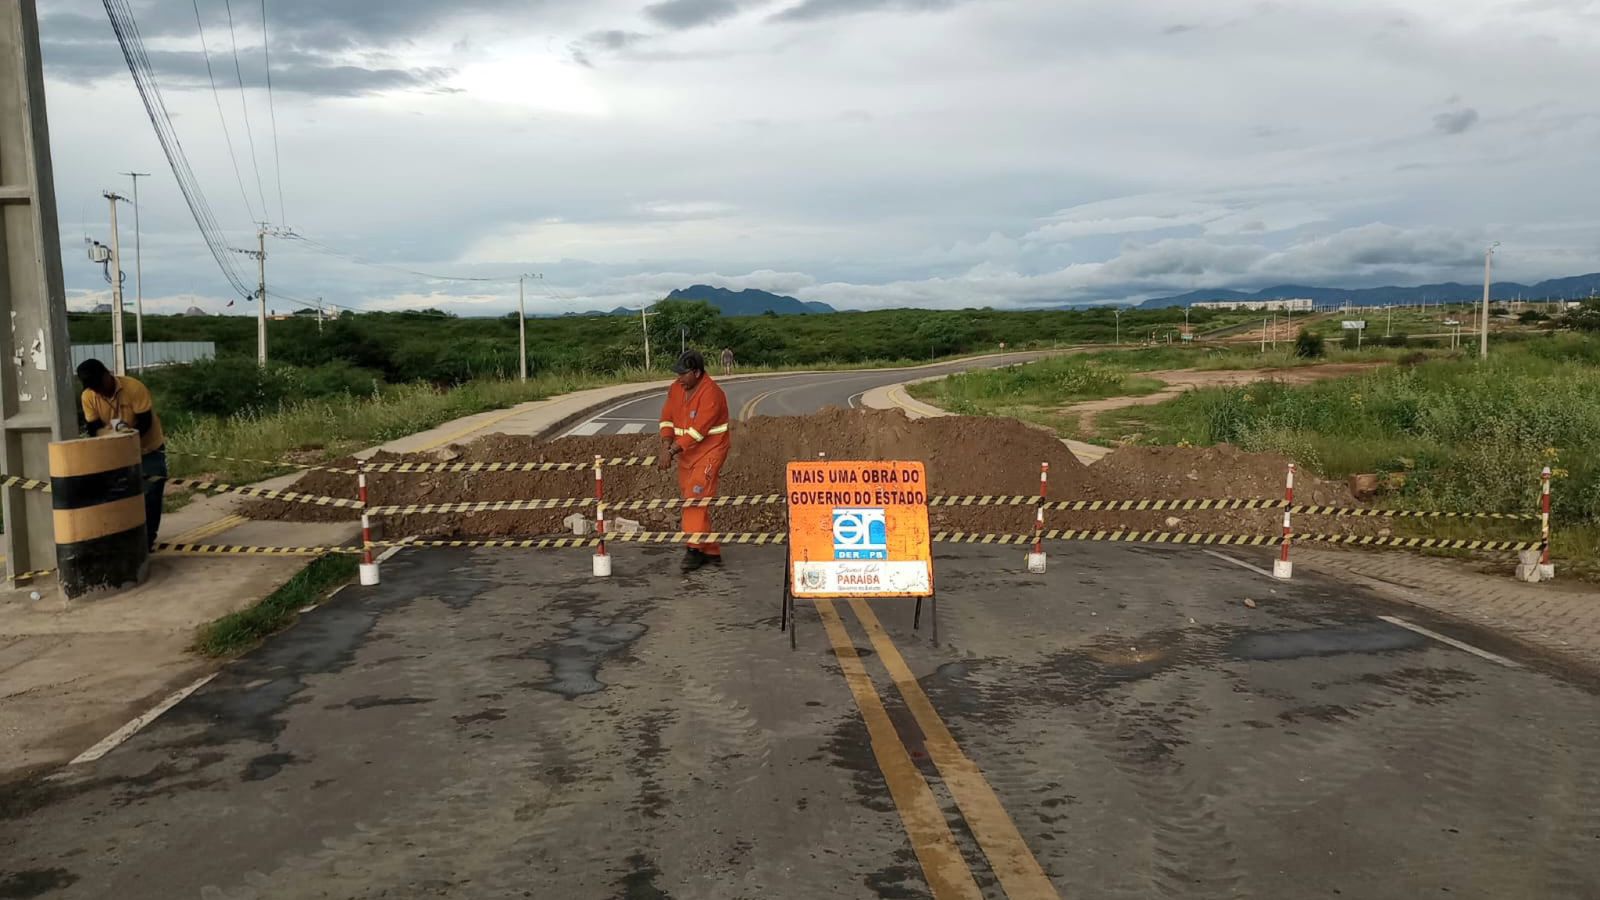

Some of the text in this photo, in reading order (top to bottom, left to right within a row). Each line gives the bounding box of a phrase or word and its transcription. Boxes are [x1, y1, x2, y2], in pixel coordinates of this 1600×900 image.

[792, 469, 919, 483] MAIS UMA OBRA DO
[791, 491, 923, 505] GOVERNO DO ESTADO
[838, 551, 860, 559] DER
